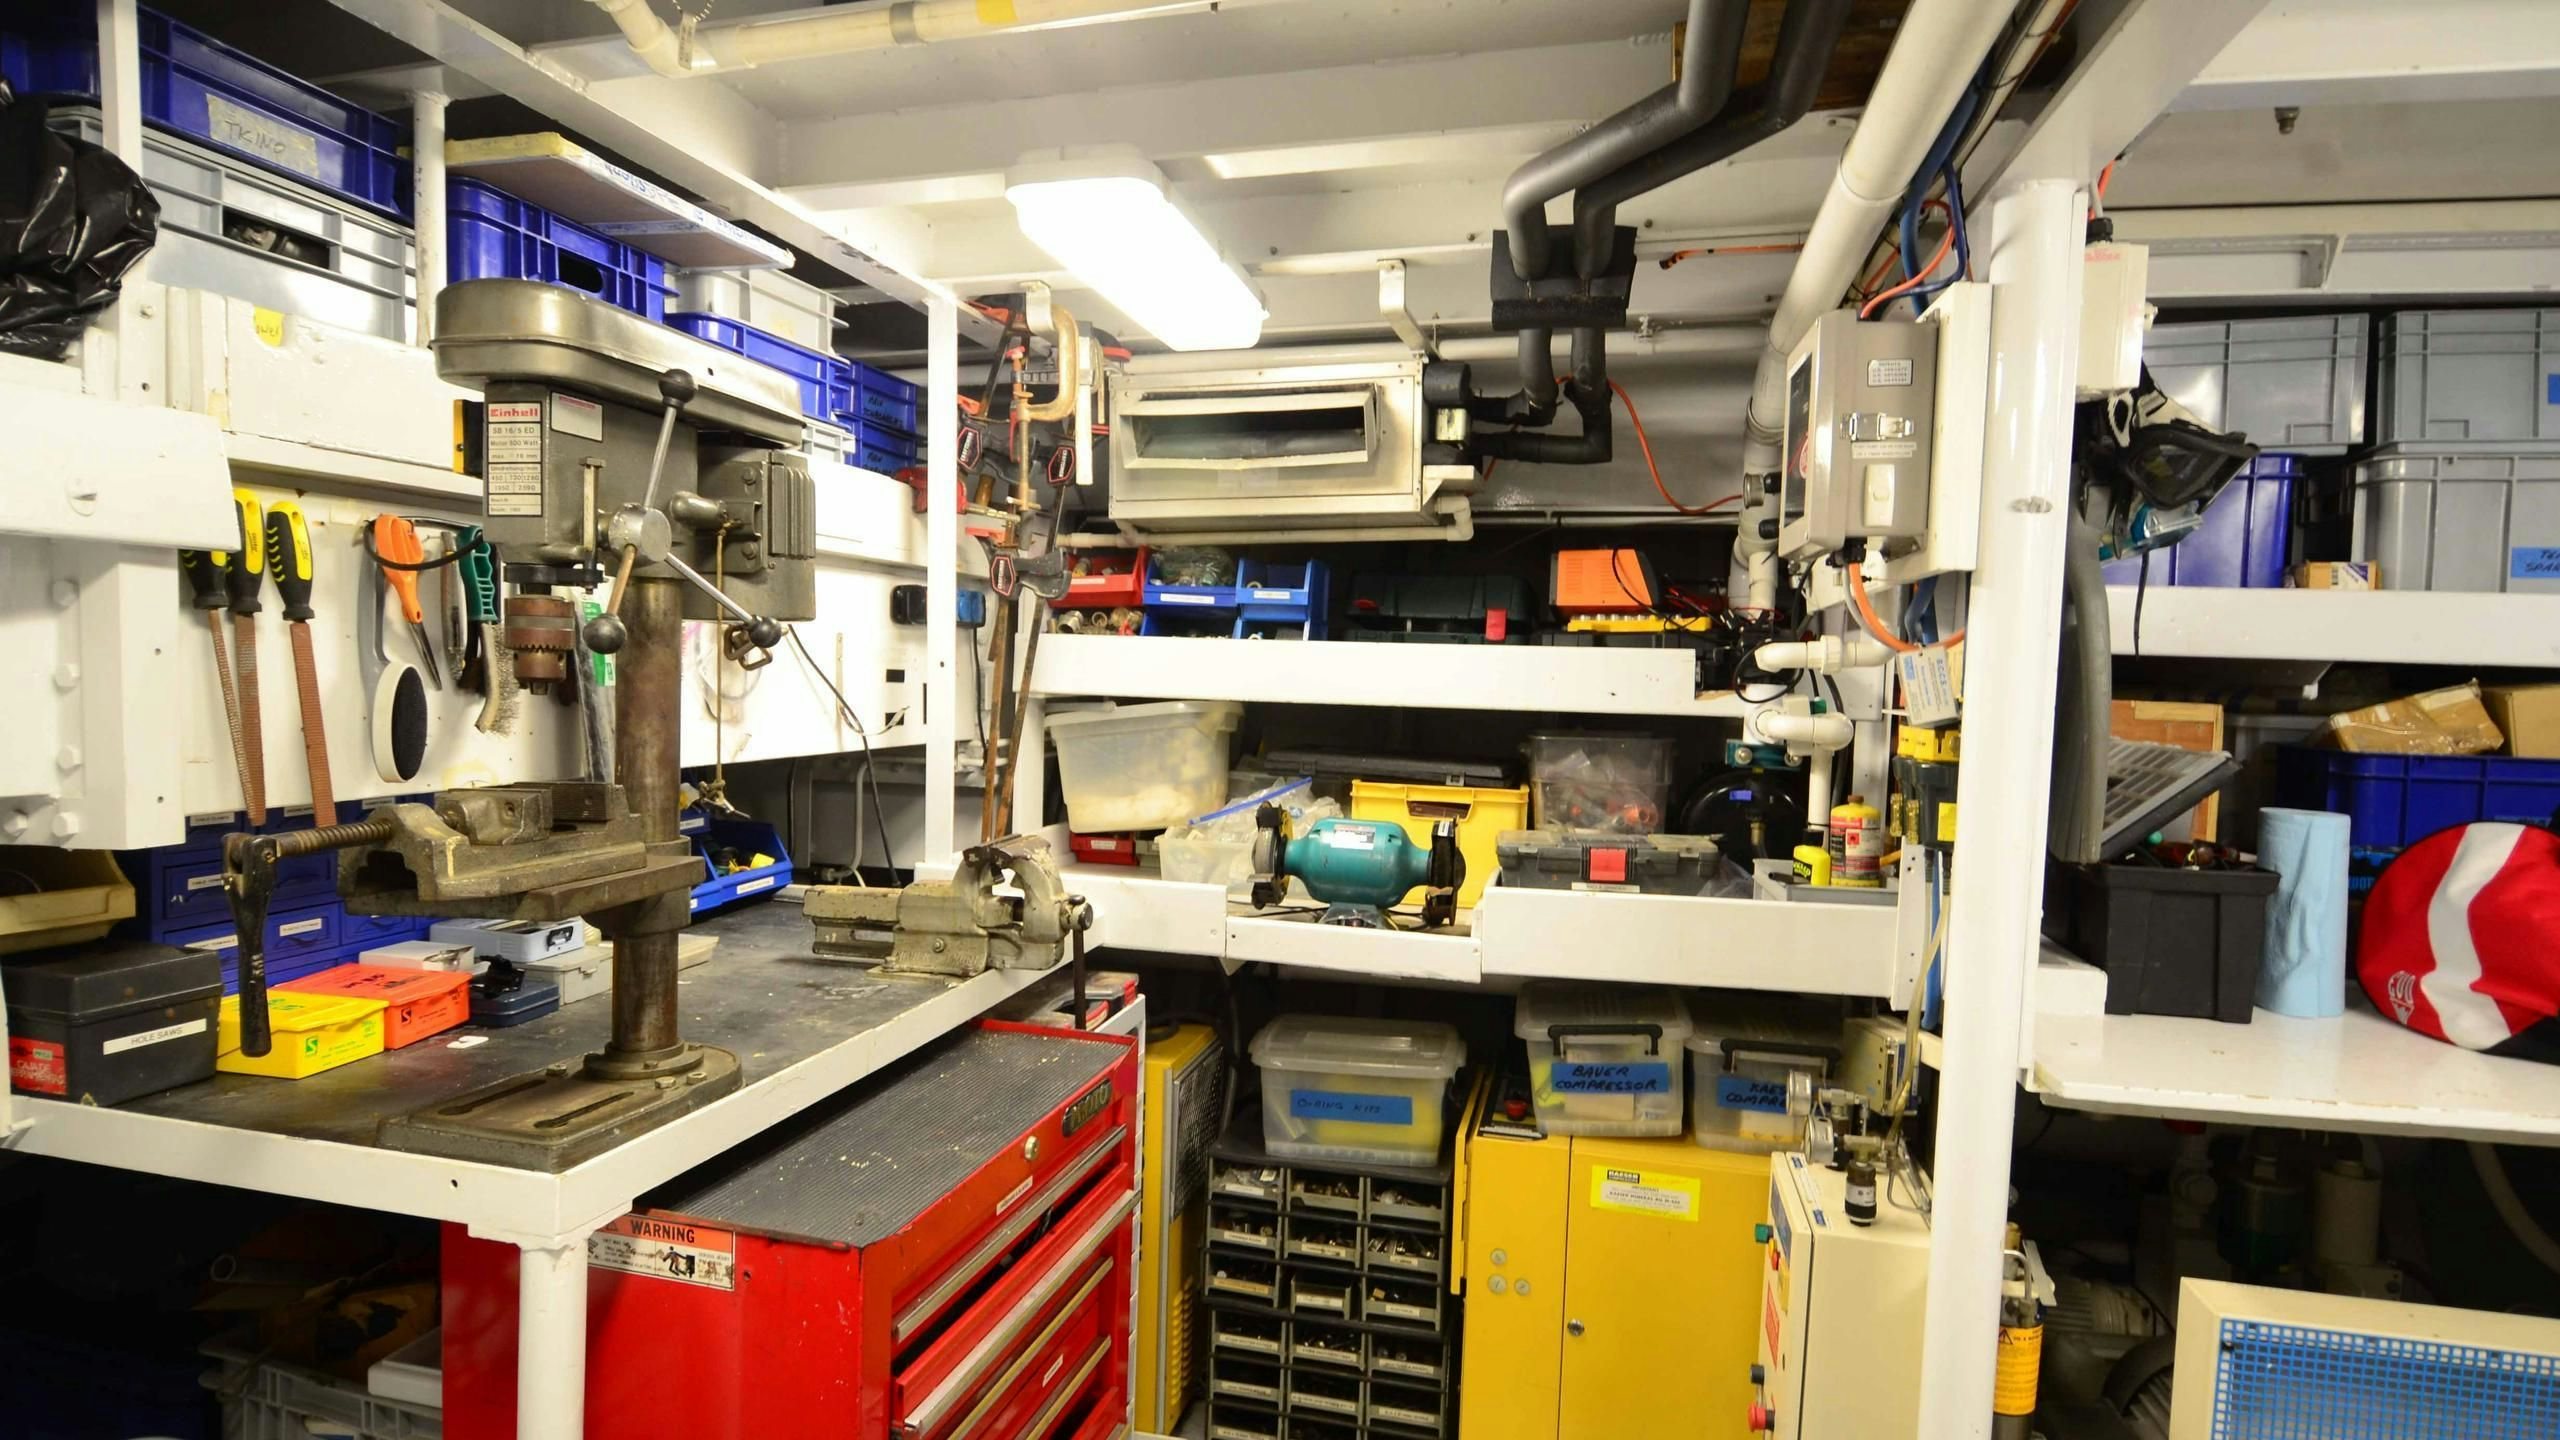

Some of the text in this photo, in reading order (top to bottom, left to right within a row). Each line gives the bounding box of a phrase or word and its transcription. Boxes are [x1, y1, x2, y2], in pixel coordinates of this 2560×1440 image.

[490, 407, 538, 417] Einhell
[524, 426, 535, 434] ED
[131, 1026, 183, 1046] HOLE SAWS
[1572, 1064, 1629, 1078] BAUER
[1555, 1079, 1657, 1092] COMPRESSOR
[1354, 1104, 1381, 1114] KITS
[631, 1219, 695, 1244] WARNING
